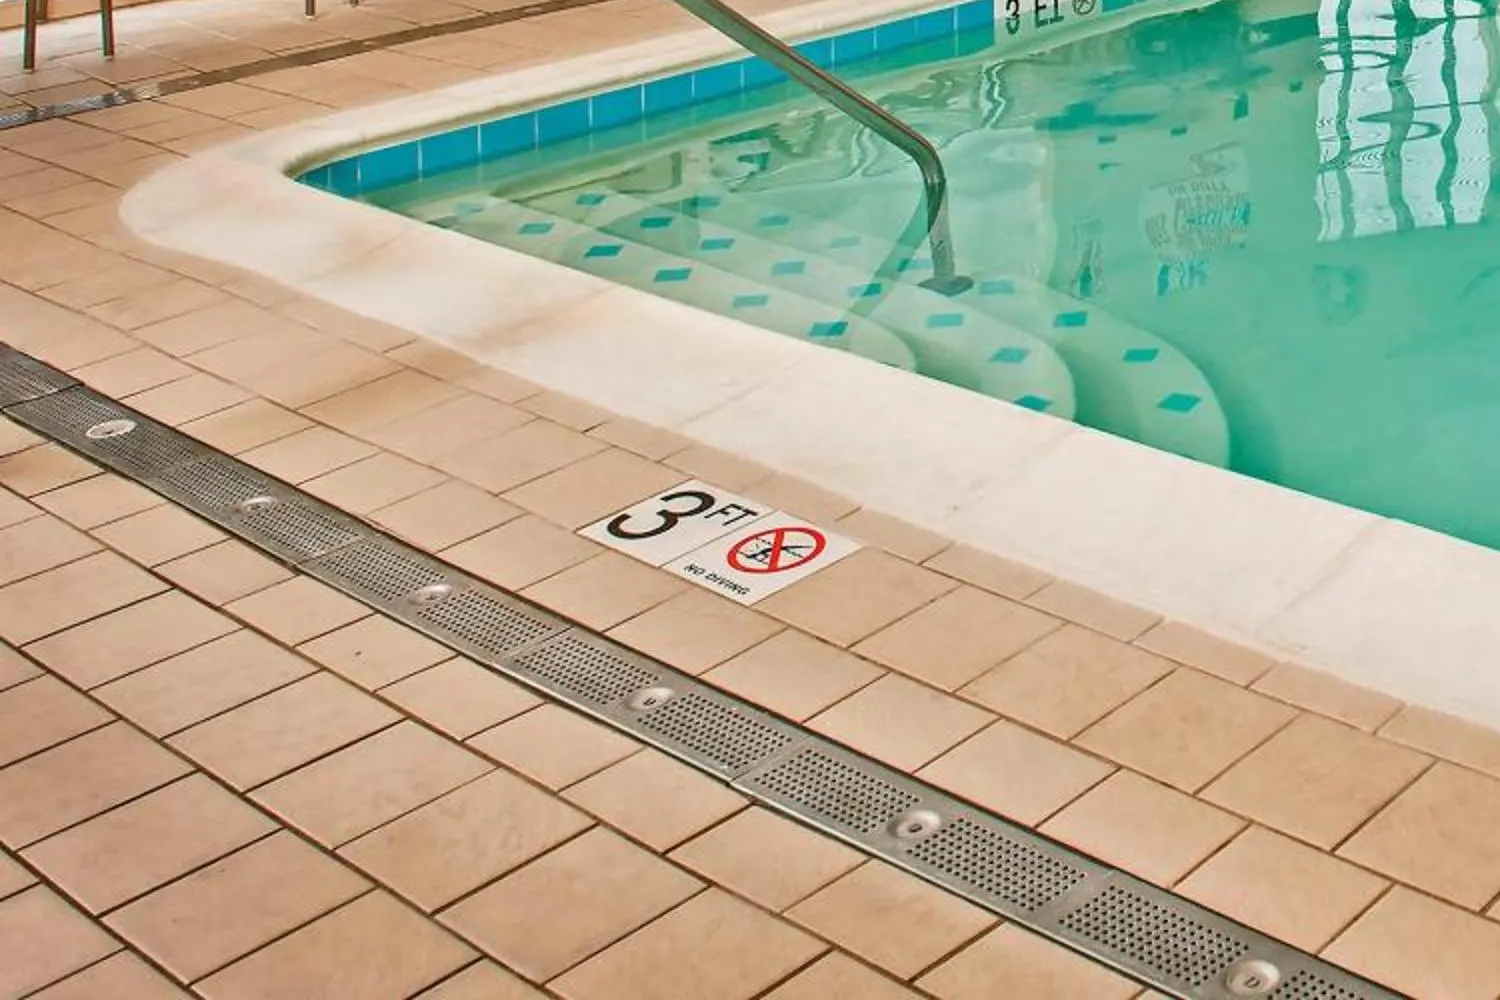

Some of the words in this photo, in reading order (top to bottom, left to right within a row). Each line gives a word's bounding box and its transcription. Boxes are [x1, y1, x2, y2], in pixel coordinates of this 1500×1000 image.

[607, 490, 715, 540] 3
[704, 503, 758, 527] FT
[684, 563, 705, 576] NO
[705, 573, 750, 595] DIVING
